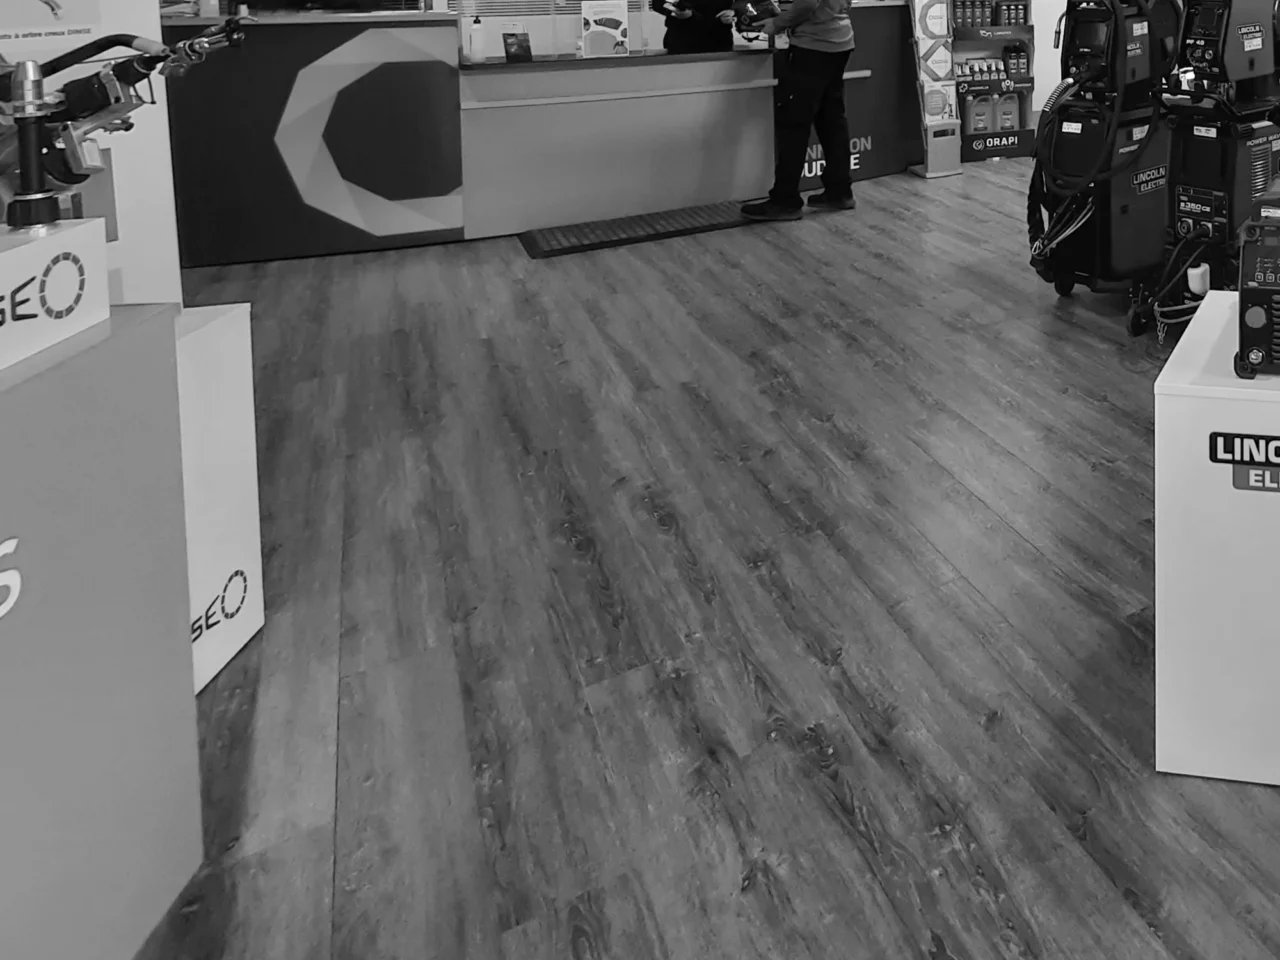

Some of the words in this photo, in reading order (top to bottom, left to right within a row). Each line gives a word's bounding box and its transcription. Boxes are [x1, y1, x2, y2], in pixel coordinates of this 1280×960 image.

[986, 136, 1018, 147] ORAPI
[1133, 166, 1166, 185] LINCOLN
[1140, 178, 1166, 192] ELECTRI
